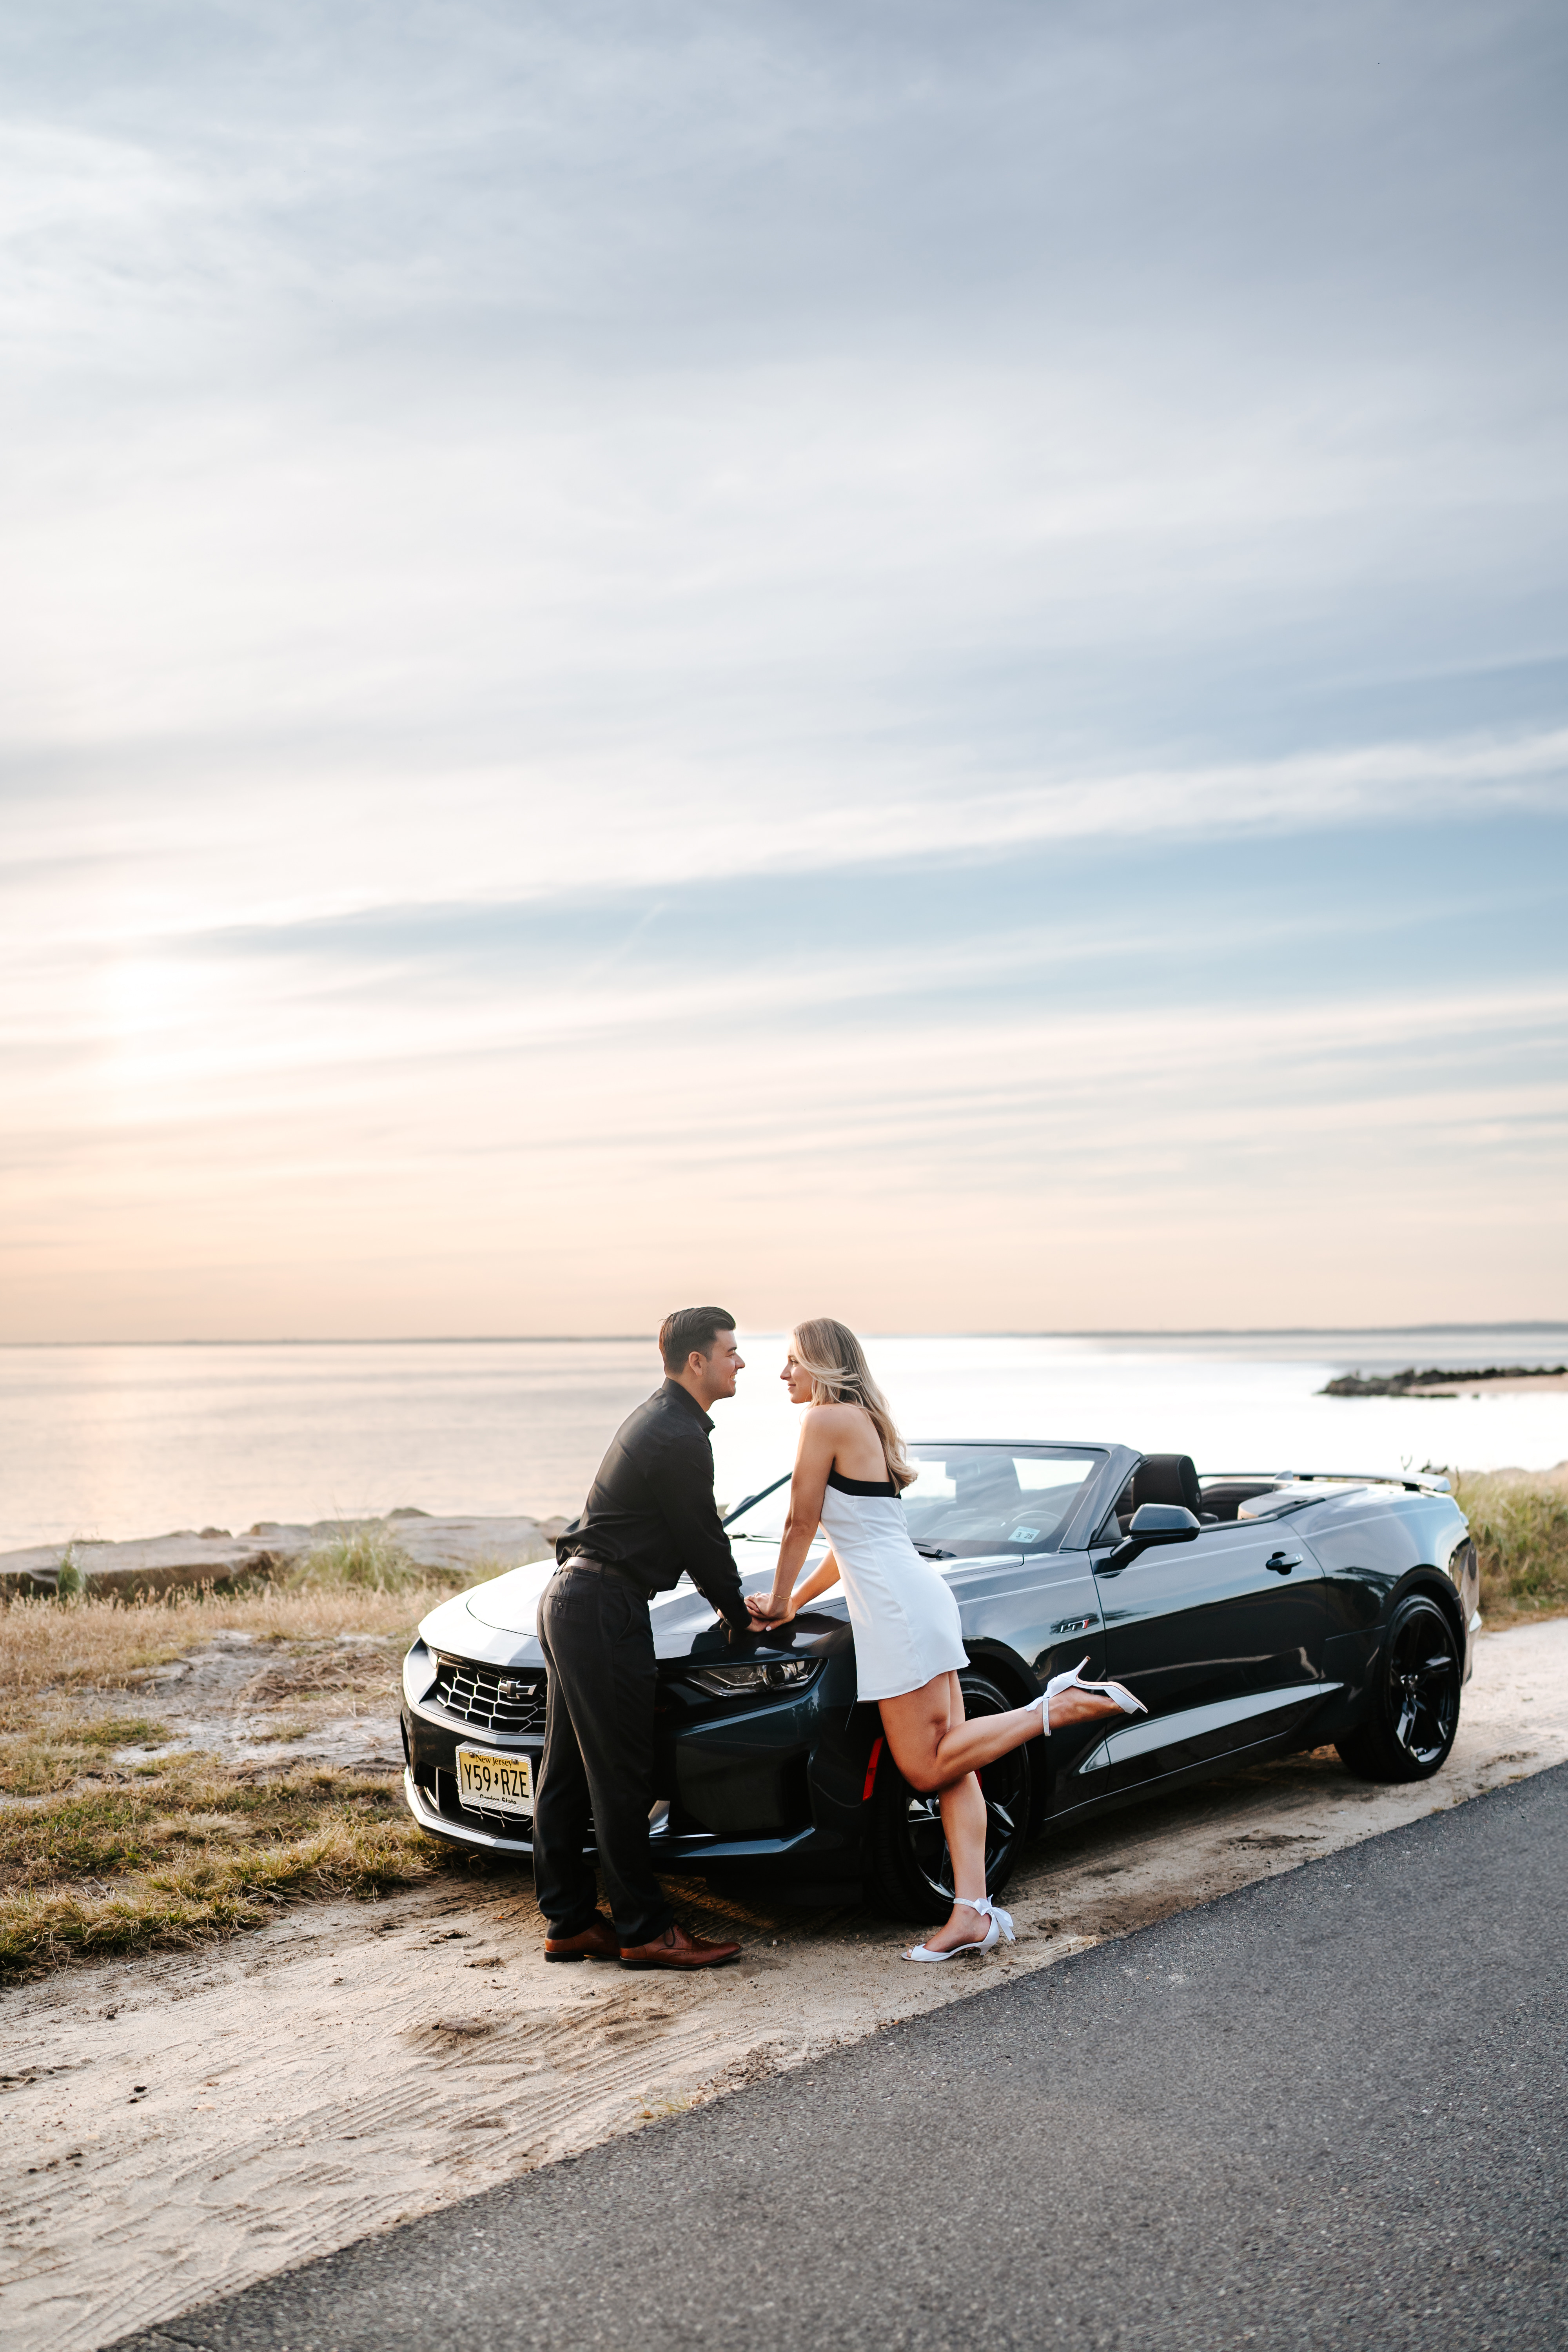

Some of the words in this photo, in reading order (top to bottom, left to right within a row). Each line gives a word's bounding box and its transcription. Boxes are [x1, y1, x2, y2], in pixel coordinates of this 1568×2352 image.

[1060, 1619, 1089, 1633] LT1
[475, 1754, 491, 1763] New
[492, 1757, 512, 1768] Jersey
[464, 1764, 491, 1792] Y59
[500, 1768, 529, 1798] RZE
